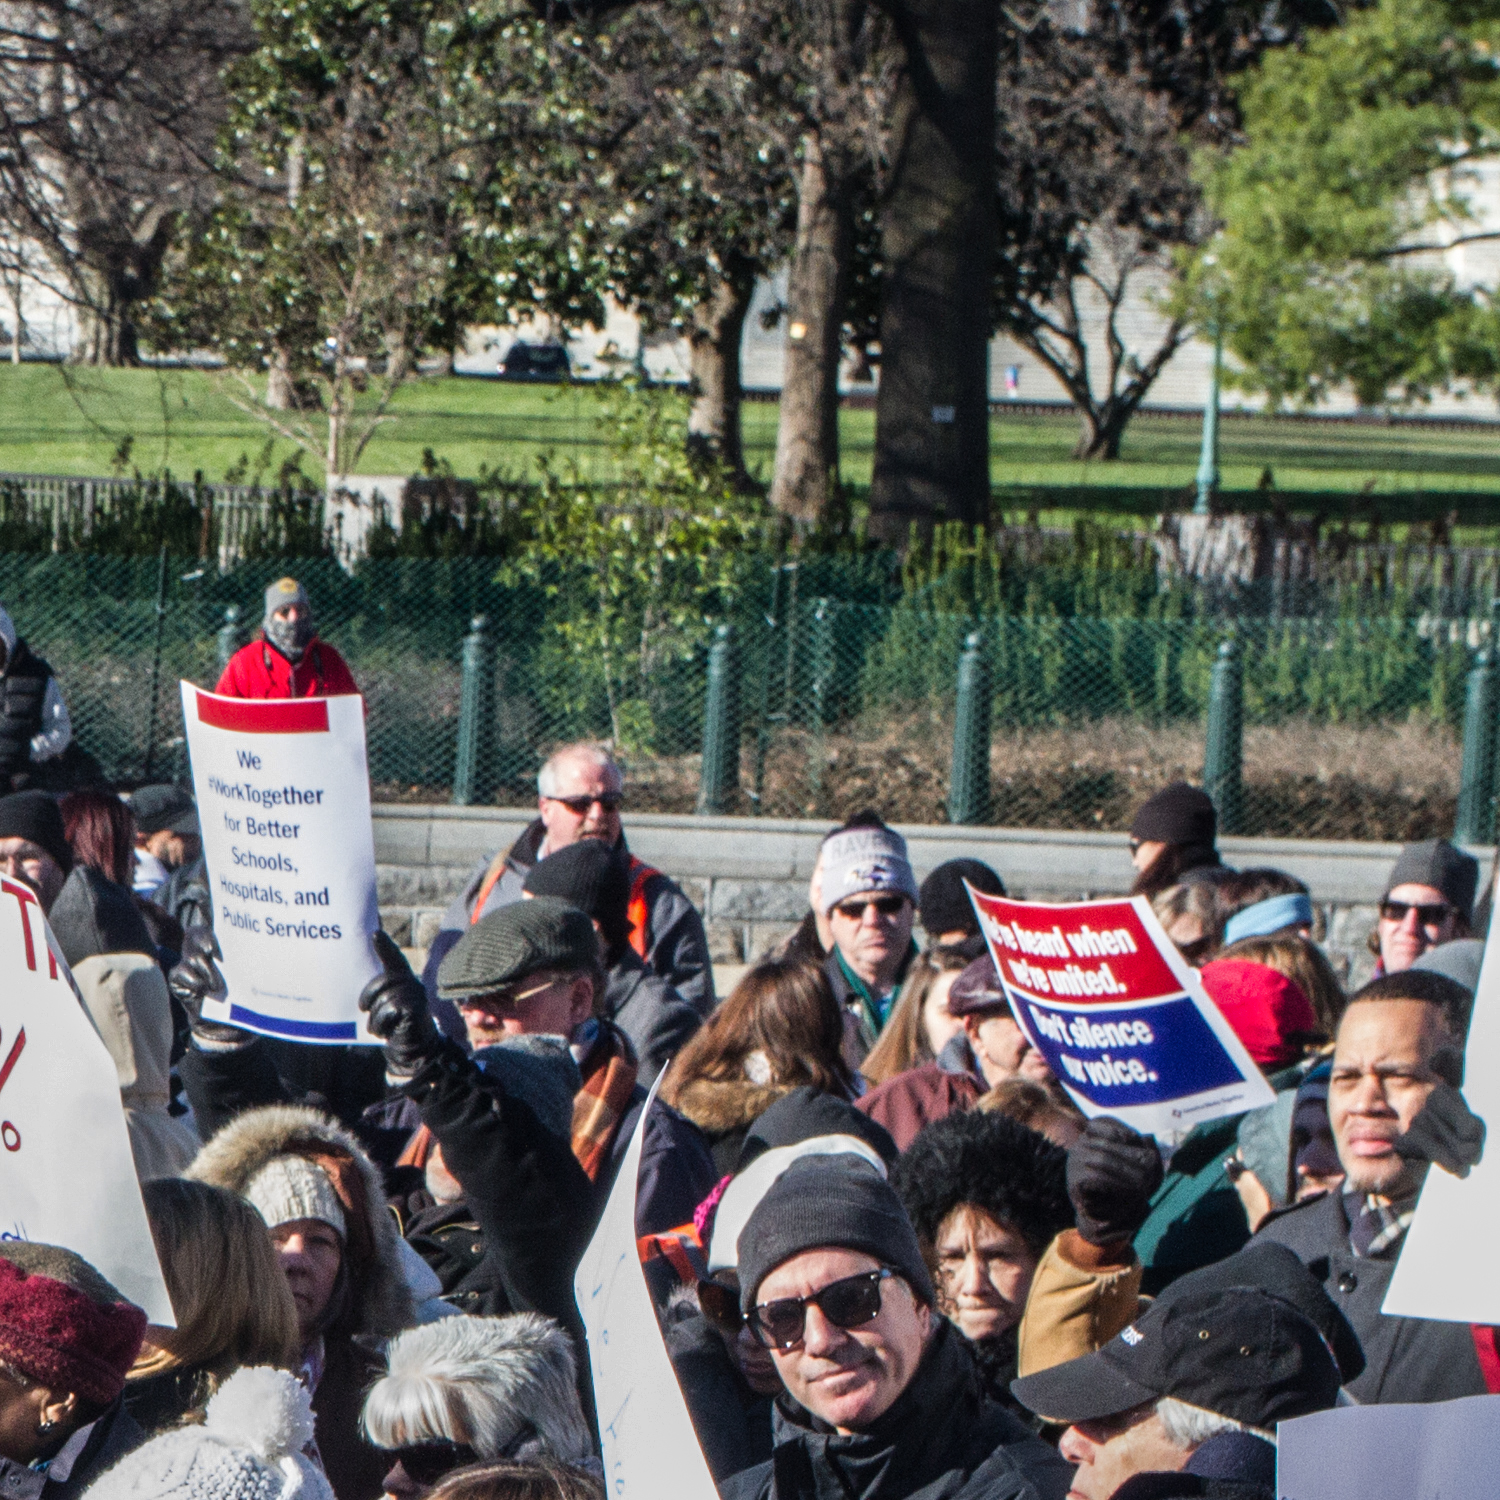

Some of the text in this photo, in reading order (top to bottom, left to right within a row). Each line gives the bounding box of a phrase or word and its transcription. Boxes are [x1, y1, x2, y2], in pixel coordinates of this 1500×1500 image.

[236, 749, 262, 771] We
[208, 776, 324, 809] #WorkTogether
[224, 811, 300, 839] for Better
[231, 846, 299, 876] Schools,
[220, 875, 330, 907] Hospitals, and
[222, 906, 343, 940] Public Services
[1011, 921, 1071, 958] heard
[1066, 925, 1138, 958] when
[1047, 962, 1128, 997] united.
[1069, 1016, 1154, 1049] silence
[1083, 1054, 1158, 1087] voice.
